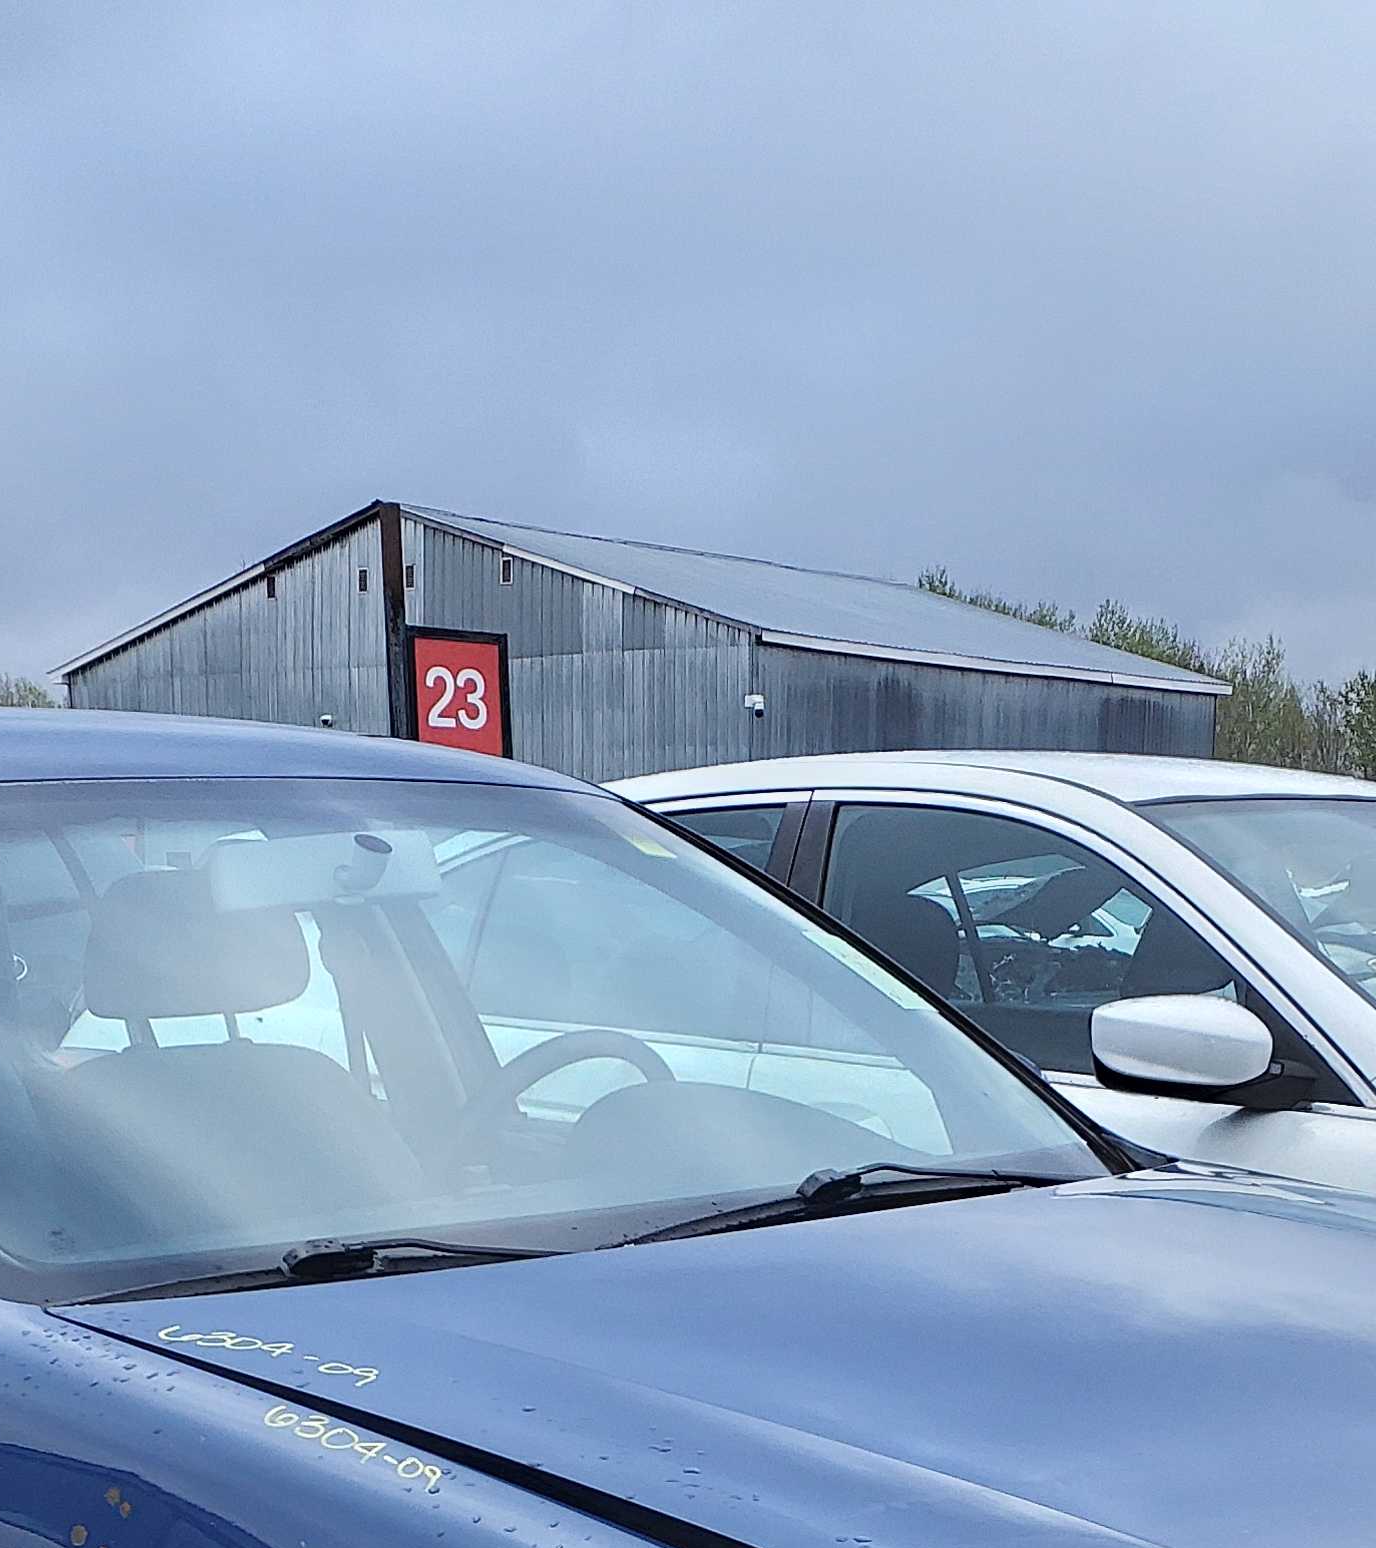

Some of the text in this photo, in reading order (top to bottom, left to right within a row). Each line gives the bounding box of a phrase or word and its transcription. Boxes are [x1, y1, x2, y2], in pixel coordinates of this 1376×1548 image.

[425, 666, 488, 730] 23
[158, 1325, 381, 1387] 6304-09
[263, 1405, 442, 1492] 6304-09
